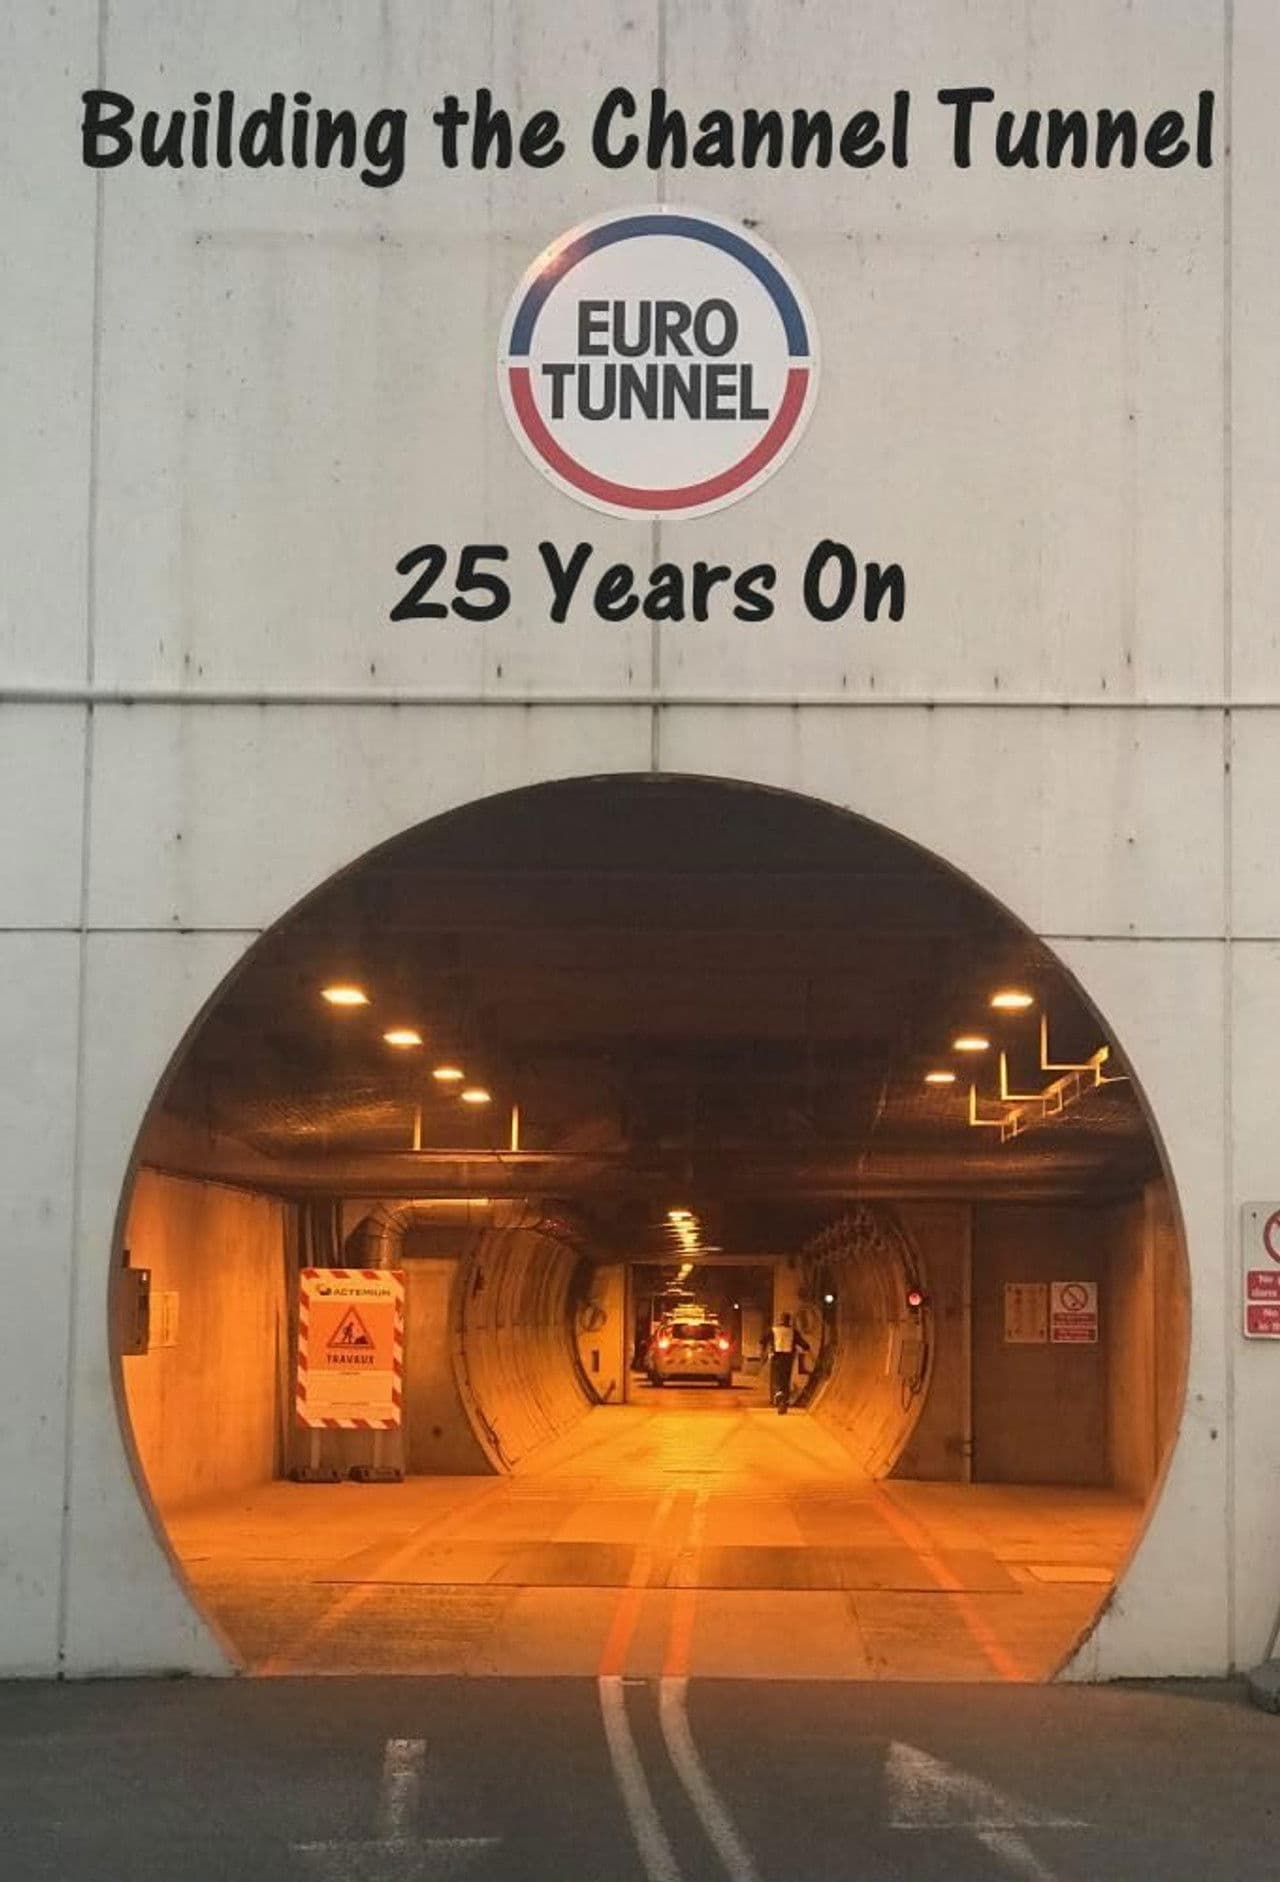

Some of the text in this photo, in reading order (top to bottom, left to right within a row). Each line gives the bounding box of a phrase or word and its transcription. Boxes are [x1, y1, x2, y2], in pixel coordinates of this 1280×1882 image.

[578, 298, 739, 358] EURO
[542, 363, 770, 421] TUNNEL
[333, 1287, 391, 1297] ACTEMIUM
[327, 1354, 375, 1365] TRAVAUX
